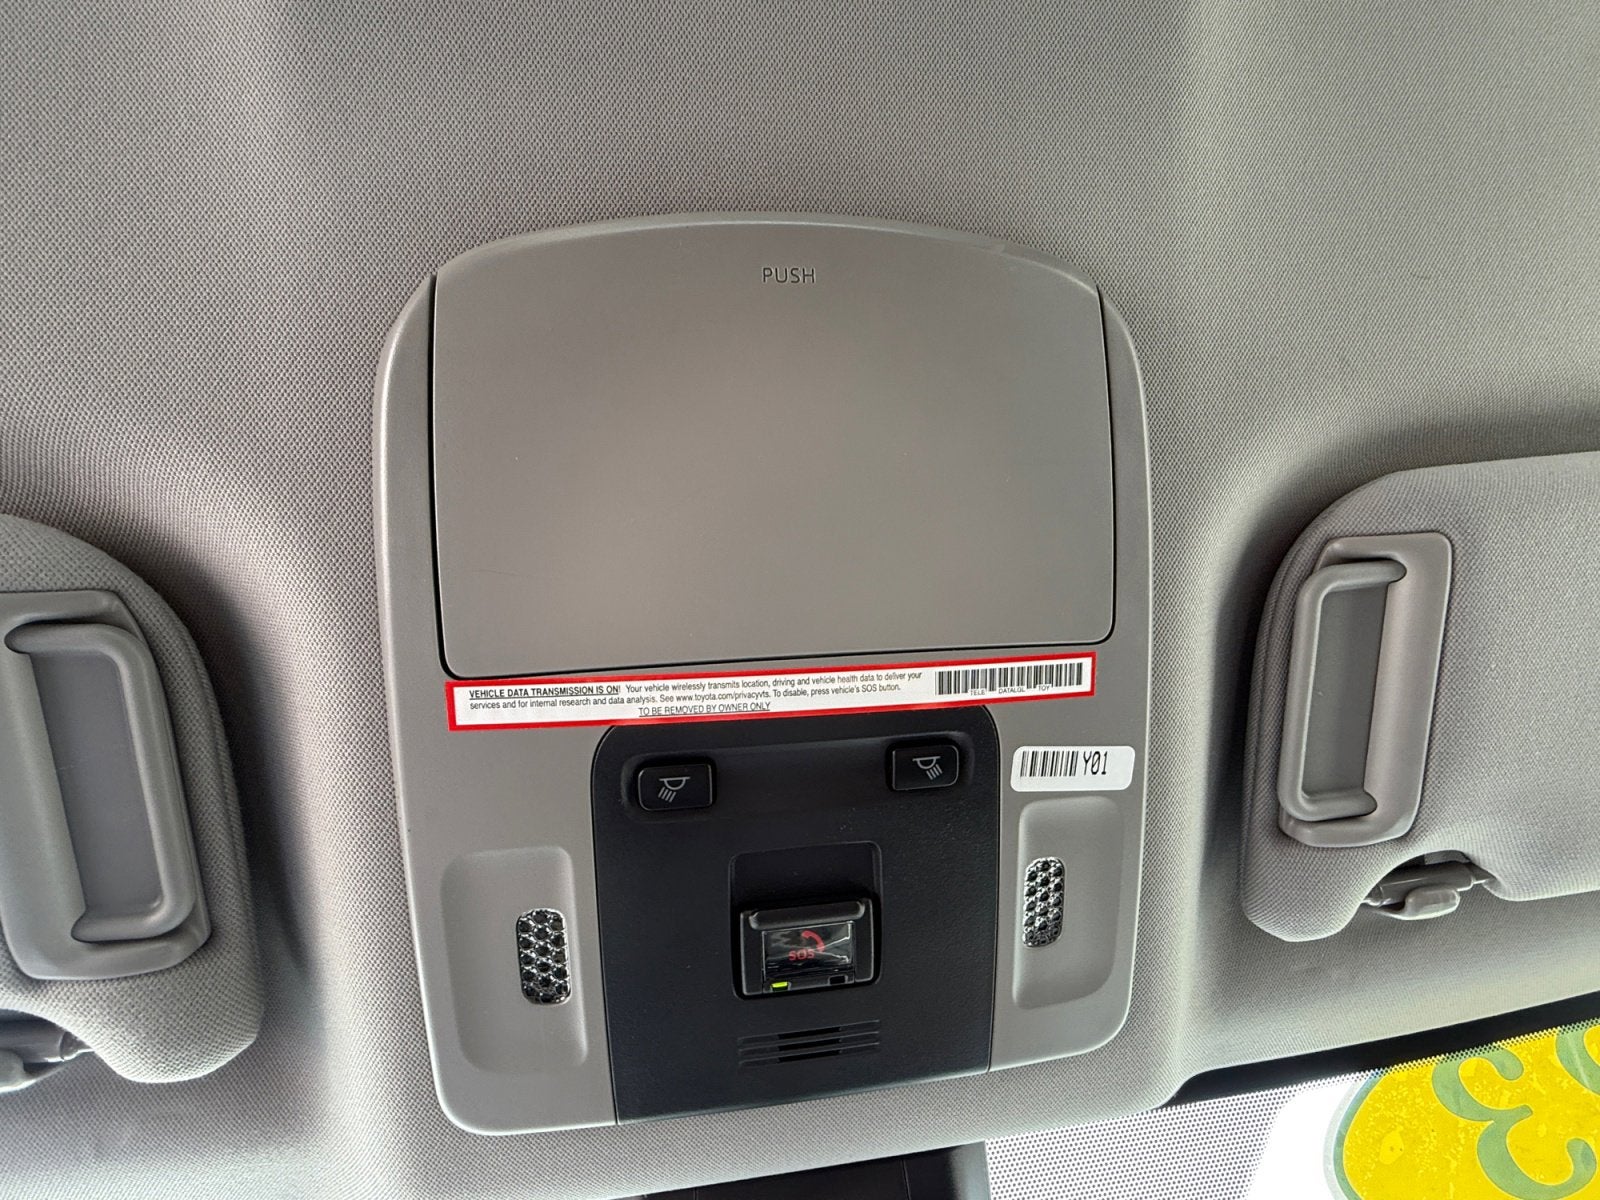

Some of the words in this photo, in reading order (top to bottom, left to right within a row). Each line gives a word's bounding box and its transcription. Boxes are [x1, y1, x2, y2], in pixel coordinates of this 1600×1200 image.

[762, 267, 815, 284] PUSH
[469, 688, 505, 699] VEHICLE
[507, 687, 529, 698] DATA
[531, 685, 594, 697] TRANSMISSION
[596, 685, 604, 695] IS
[626, 684, 642, 693] Your
[644, 683, 669, 692] vehicle
[672, 681, 706, 692] wirelessly
[708, 680, 740, 690] transmits
[741, 679, 770, 689] location,
[772, 678, 795, 688] driving
[797, 677, 809, 685] and
[811, 675, 836, 684] vehicle
[837, 674, 858, 683] health
[860, 674, 875, 682] data
[876, 673, 882, 681] to
[884, 672, 906, 681] deliver
[907, 672, 922, 682] your
[470, 701, 500, 710] services
[502, 700, 516, 709] and
[518, 700, 528, 708] for
[530, 699, 557, 707] internal
[559, 697, 591, 707] research
[593, 697, 606, 705] and
[608, 696, 624, 705] data
[626, 695, 657, 705] analysis.
[659, 694, 674, 703] See
[773, 689, 781, 698] To
[782, 688, 809, 697] disable,
[810, 687, 829, 696] press
[831, 685, 860, 694] vehicle's
[861, 684, 877, 692] SOS
[879, 683, 901, 692] button.
[638, 707, 650, 716] TO
[652, 706, 663, 715] BE
[664, 704, 704, 715] REMOVED
[706, 704, 717, 713] BY
[718, 703, 748, 712] OWNER
[750, 702, 770, 711] ONLY
[1083, 751, 1108, 775] Y01
[788, 948, 815, 961] SOS
